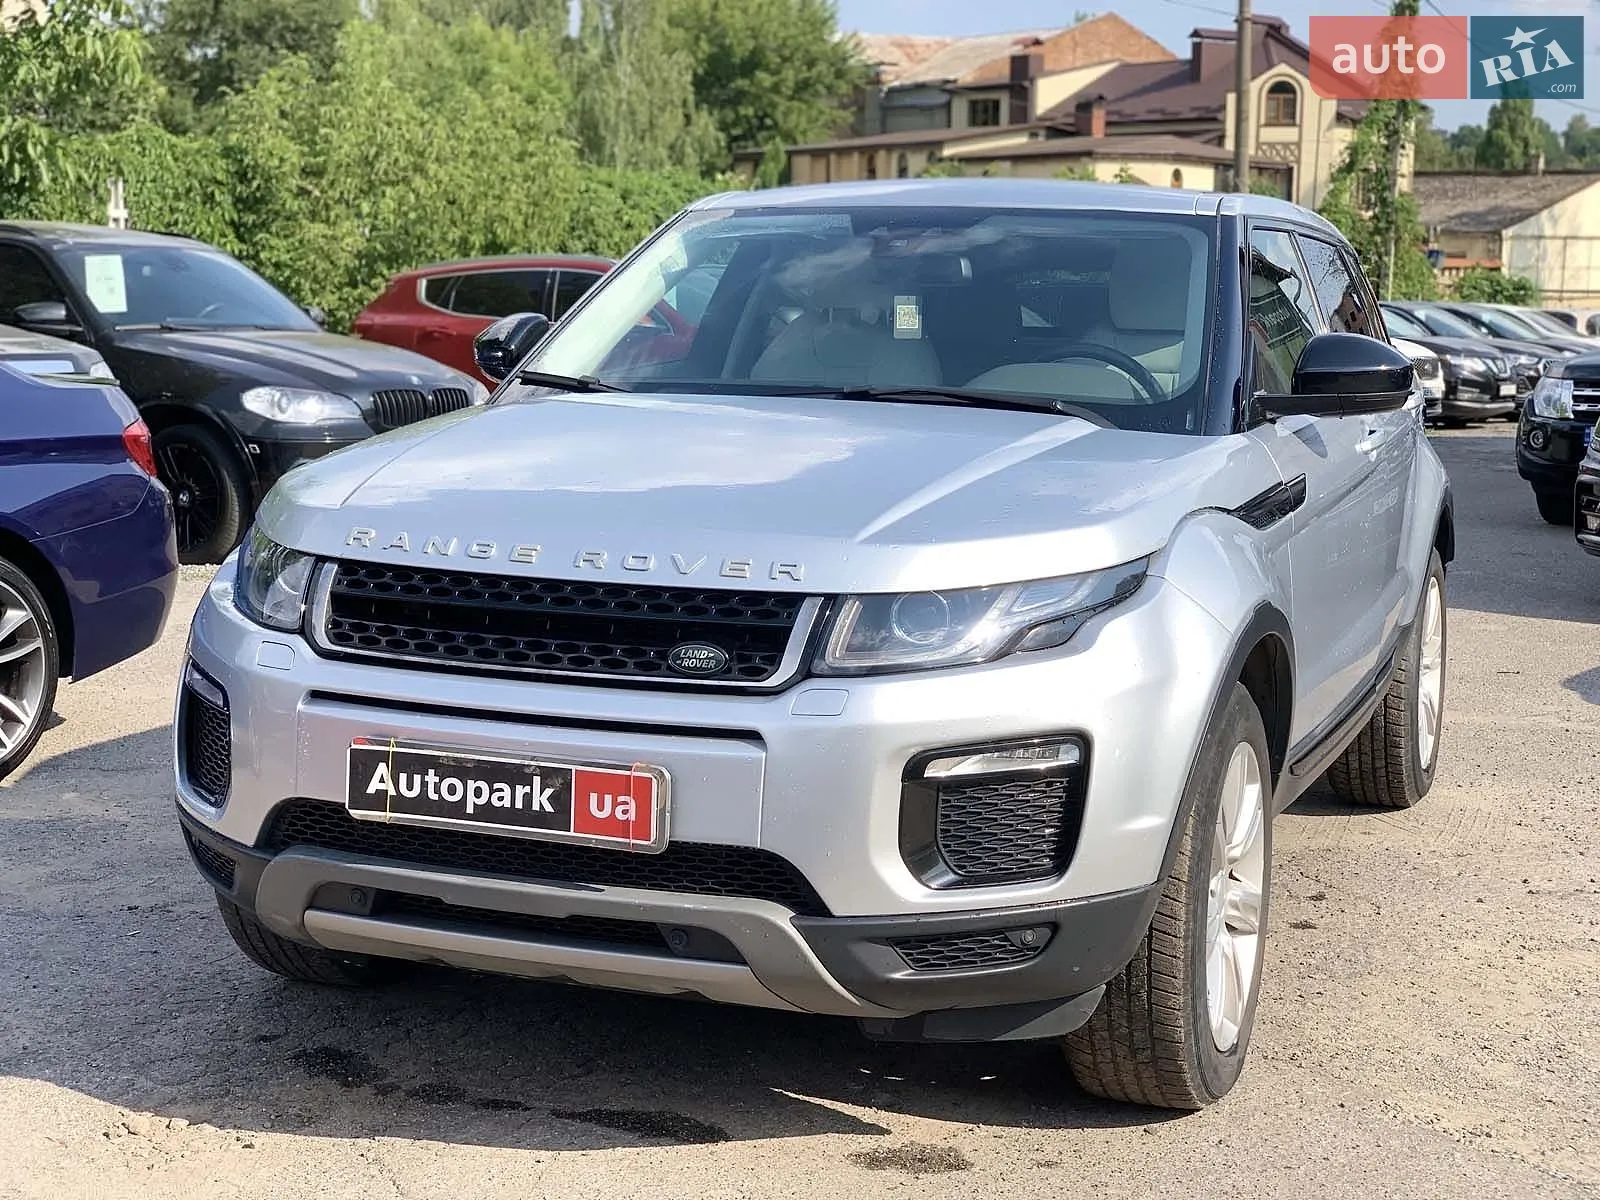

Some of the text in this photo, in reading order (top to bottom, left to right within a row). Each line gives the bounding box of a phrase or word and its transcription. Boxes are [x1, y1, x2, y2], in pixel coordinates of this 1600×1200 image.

[345, 526, 805, 582] RANGE ROVER
[365, 762, 636, 822] Autopark ua
